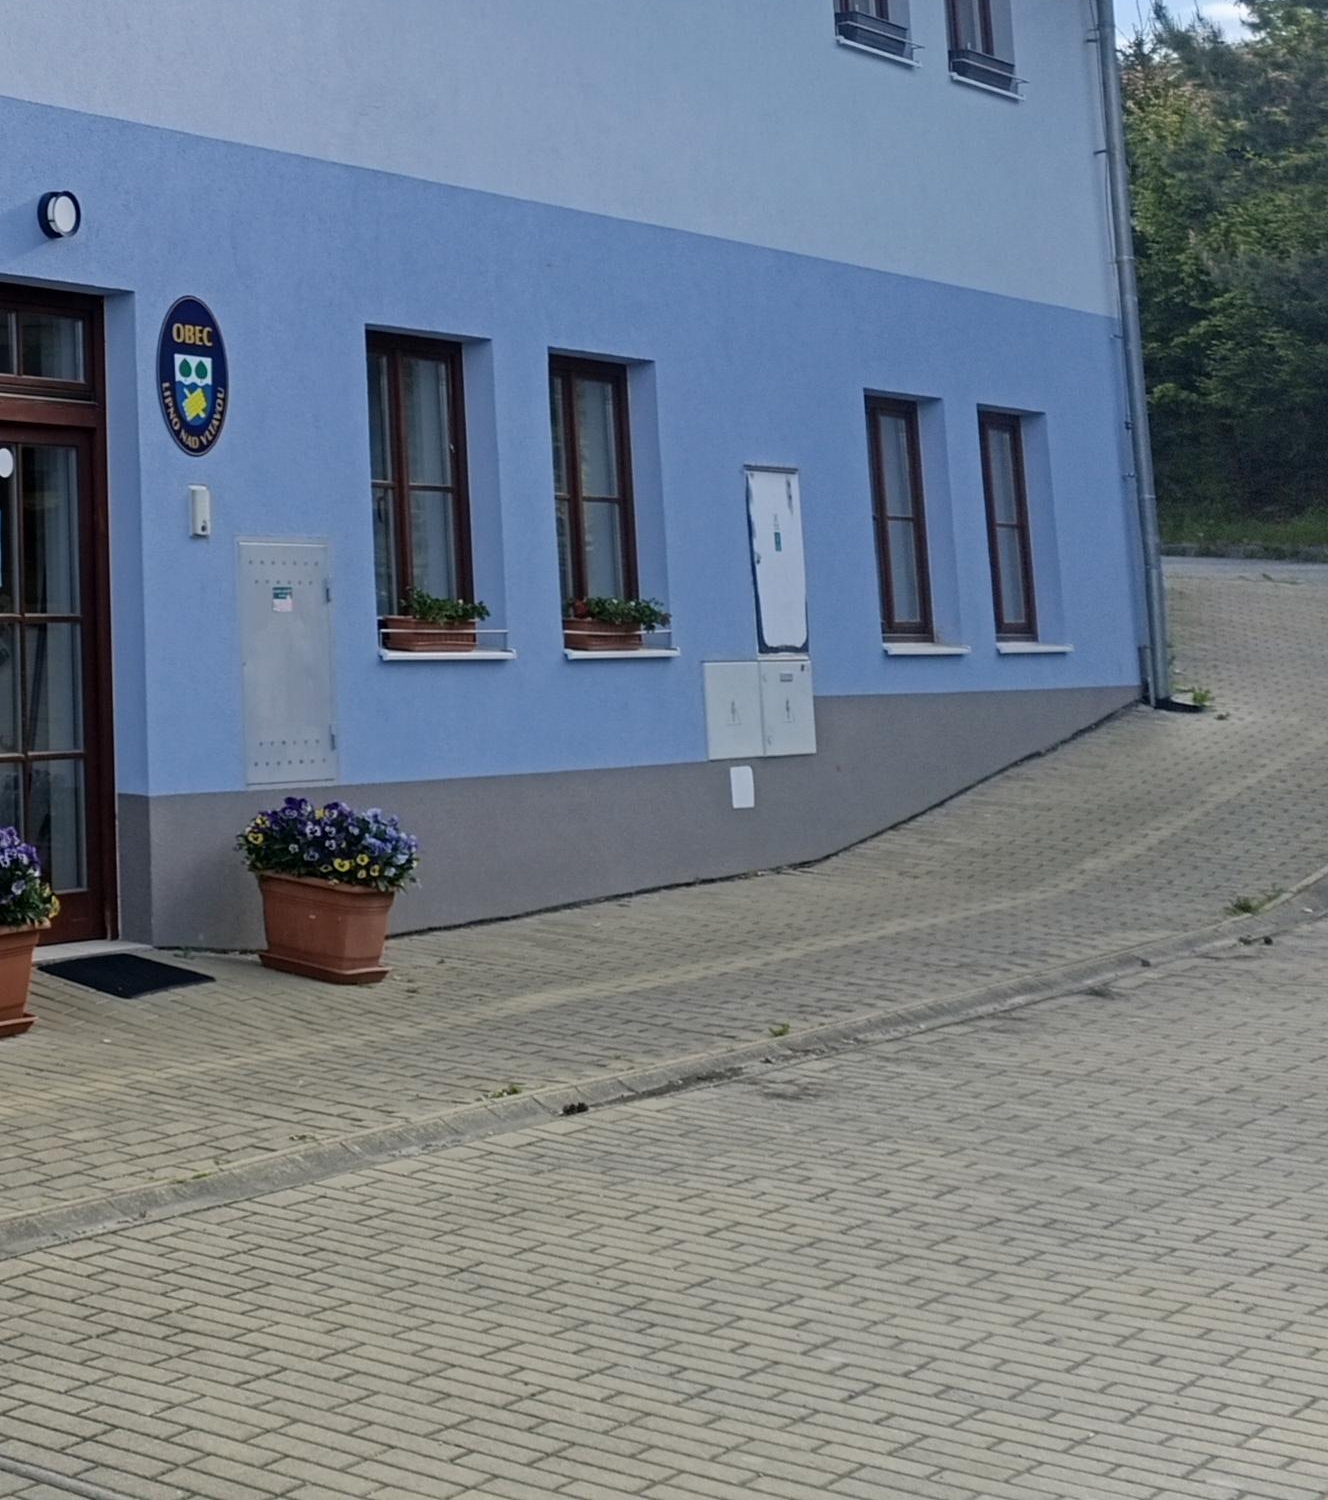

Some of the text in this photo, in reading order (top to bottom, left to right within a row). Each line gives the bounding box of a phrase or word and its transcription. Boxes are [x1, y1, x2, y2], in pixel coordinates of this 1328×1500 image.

[172, 323, 213, 347] OBEC
[162, 381, 226, 450] LIPNO NAD VLTAVOU
